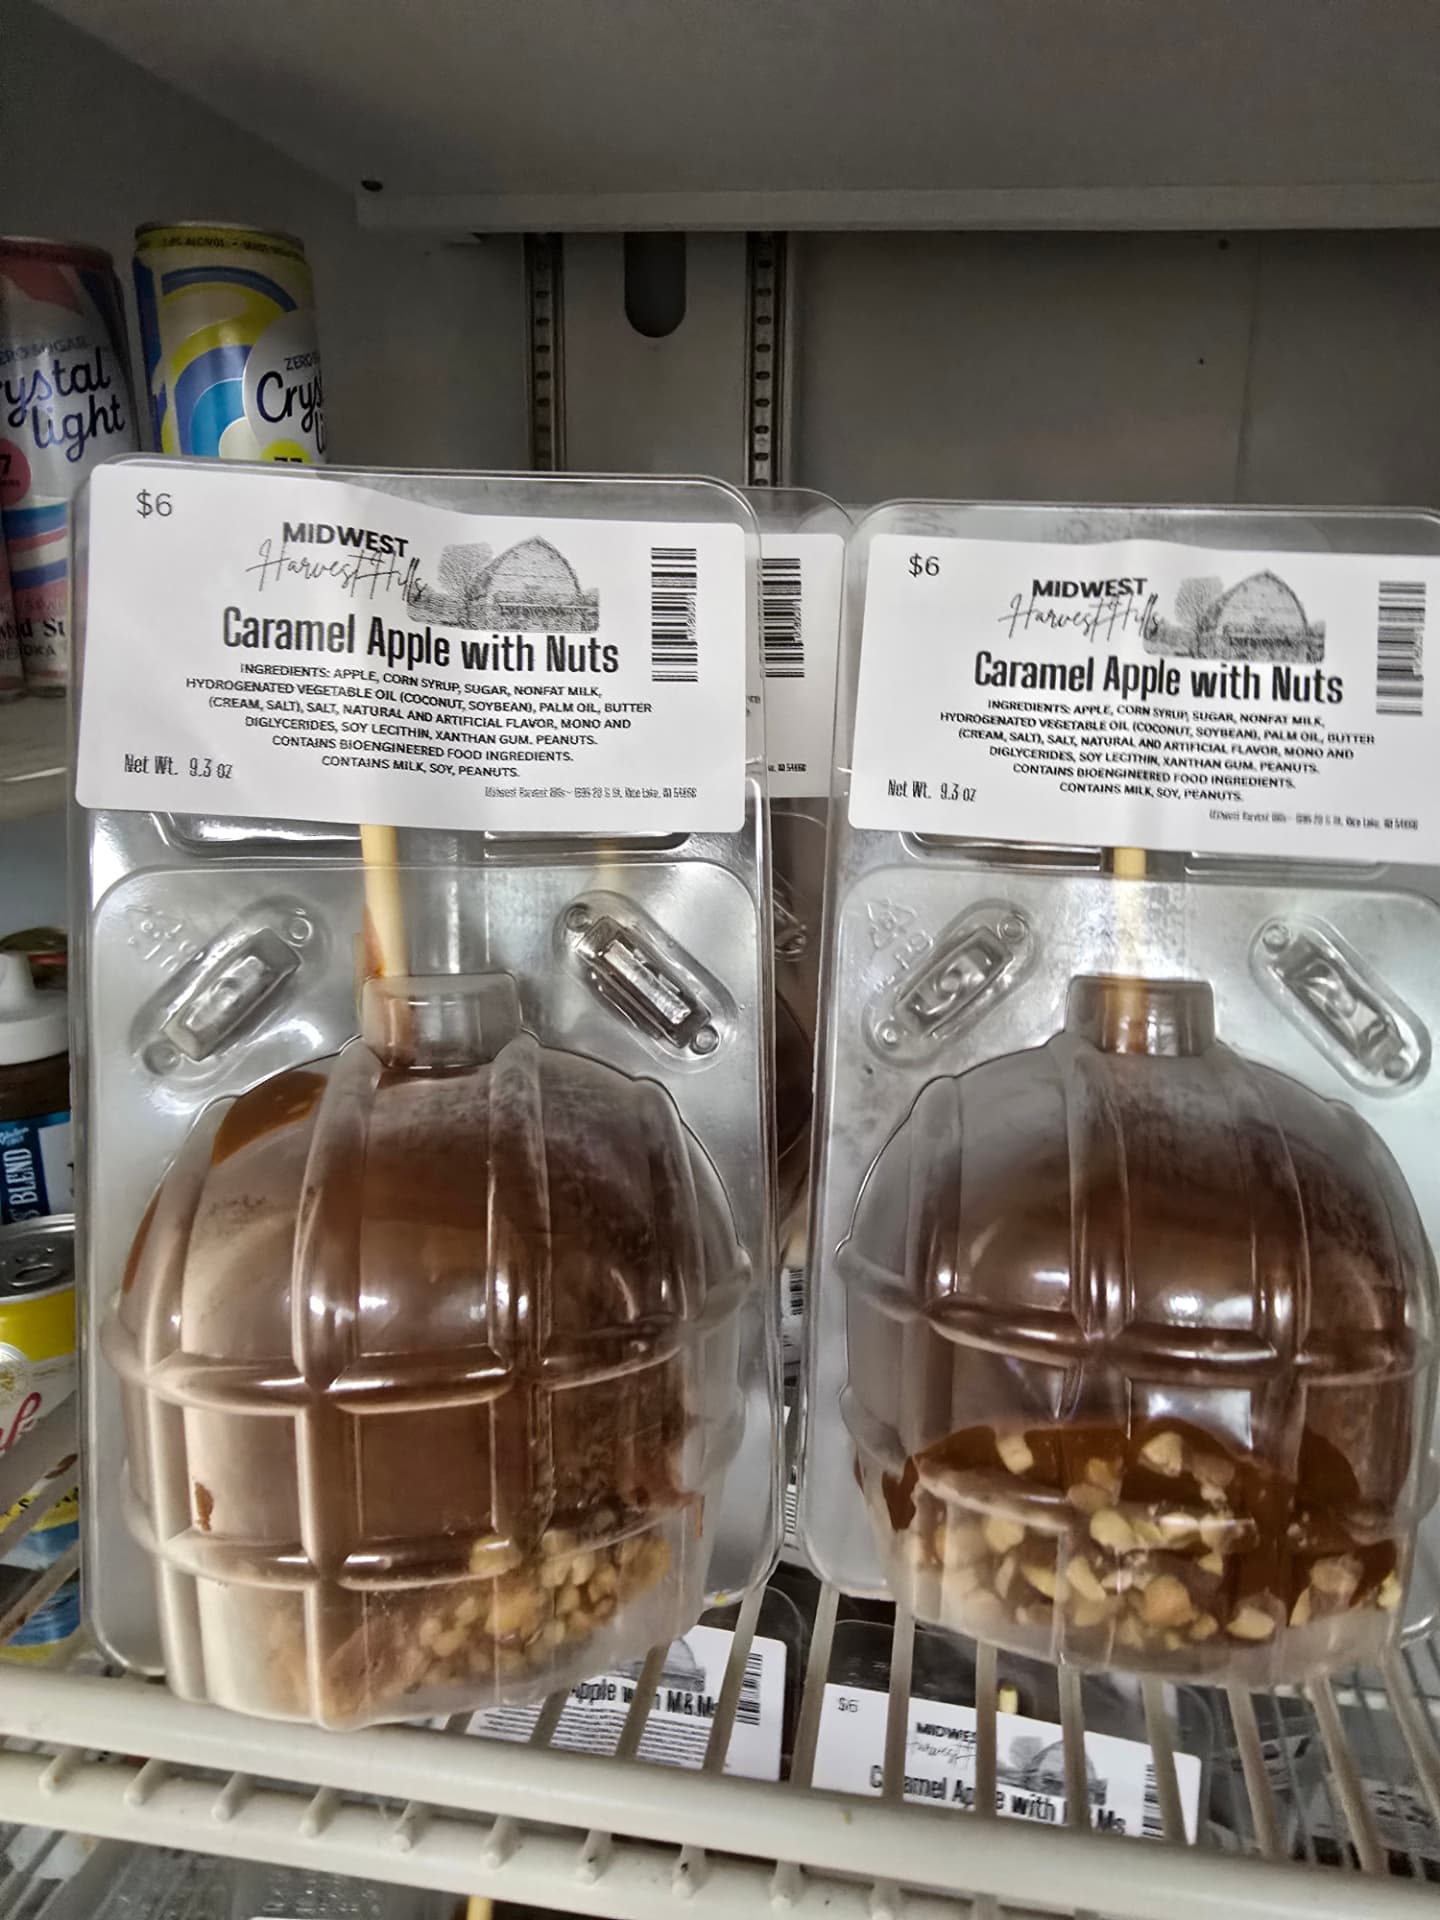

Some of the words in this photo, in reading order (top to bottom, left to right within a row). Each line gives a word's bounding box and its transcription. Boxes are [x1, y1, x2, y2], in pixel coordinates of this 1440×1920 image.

[0, 347, 110, 428] ystal
[32, 394, 125, 463] light
[136, 488, 172, 518] $6
[283, 522, 409, 557] MIDWEST
[245, 538, 385, 597] Harvest
[909, 552, 939, 578] $6
[1032, 577, 1147, 600] MIDWEST
[223, 605, 355, 654] Caramel
[367, 615, 450, 671] Apple
[461, 634, 534, 672] with
[547, 635, 619, 673] Nuts
[240, 663, 330, 679] INGREDIENTS:
[333, 669, 380, 683] APPLE,
[383, 672, 418, 686] CORN
[422, 678, 462, 694] SYRUP,
[464, 683, 511, 697] SUGAR,
[514, 685, 564, 697] NONFAT
[568, 686, 602, 698] MILK,
[974, 650, 1094, 692] Caramel
[1103, 655, 1181, 702] Apple
[1190, 662, 1261, 700] with
[1271, 664, 1344, 705] Nuts
[186, 678, 294, 694] HYDROGENATED
[298, 684, 372, 700] VEGETABLE
[375, 689, 396, 700] OIL
[400, 691, 466, 710] (COCONUT,
[539, 702, 573, 713] PALM
[576, 702, 601, 714] OIL,
[604, 702, 652, 714] BUTTER
[209, 697, 264, 711] (CREAM,
[266, 699, 304, 714] SALT),
[307, 702, 339, 715] SALT,
[343, 704, 404, 720] NATURAL
[407, 709, 432, 722] AND
[436, 714, 502, 728] ARTIFICIAL
[506, 718, 557, 730] FLAVOR,
[561, 719, 600, 729] MONO
[604, 719, 631, 729] AND
[987, 699, 1071, 714] INGREDIENTS:
[1073, 704, 1113, 717] APPLE,
[1116, 705, 1150, 717] CORN
[1153, 707, 1189, 722] SYRUP,
[1192, 711, 1236, 724] SUGAR,
[1240, 713, 1288, 725] NONFAT
[1292, 716, 1325, 727] MILK,
[245, 716, 338, 733] DIGLYCERIDES,
[341, 721, 368, 733] SOY
[371, 724, 433, 740] LECITHIN,
[436, 730, 496, 744] XANTHAN
[536, 735, 598, 745] PEANUTS.
[940, 712, 1036, 727] HYDROGENATED
[1039, 717, 1106, 731] VEGETABLE
[1109, 721, 1129, 731] OIL
[1132, 722, 1193, 737] (COCONUT,
[1264, 730, 1297, 741] PALM
[1300, 732, 1324, 744] OIL,
[1327, 733, 1375, 745] BUTTER
[272, 735, 336, 749] CONTAINS
[340, 740, 444, 758] BIOENGINEERED
[447, 748, 482, 760] FOOD
[486, 751, 574, 762] INGREDIENTS.
[958, 728, 1007, 742] (CREAM,
[1047, 734, 1077, 746] SALT,
[1081, 736, 1135, 748] NATURAL
[1138, 739, 1161, 749] AND
[1164, 741, 1228, 754] ARTIFICIAL
[1231, 745, 1281, 757] FLAVOR,
[1284, 747, 1323, 758] MONO
[1327, 748, 1354, 759] AND
[124, 753, 149, 774] Net
[155, 755, 178, 775] Wt.
[189, 757, 212, 777] 9.3
[322, 755, 389, 769] CONTAINS
[393, 761, 426, 773] MILK,
[429, 764, 456, 776] SOY,
[458, 765, 520, 777] PEANUTS.
[989, 746, 1076, 763] DIGLYCERIDES,
[1079, 751, 1101, 762] SOY
[1105, 752, 1160, 766] LECITHIN,
[1163, 756, 1221, 770] XANTHAN
[1260, 761, 1320, 773] PEANUTS.
[887, 778, 908, 798] Net
[912, 779, 932, 799] Wt.
[940, 782, 959, 800] 9.3
[1013, 763, 1074, 777] CONTAINS
[1076, 767, 1171, 782] BIOENGINEERED
[1174, 773, 1208, 784] FOOD
[1211, 776, 1295, 788] INGREDIENTS.
[1059, 782, 1121, 795] CONTAINS
[1124, 784, 1154, 797] MILK,
[1157, 787, 1181, 800] SOY,
[1184, 789, 1243, 801] PEANUTS.
[3, 1148, 38, 1205] BLEND
[572, 1679, 617, 1706] pple
[838, 1697, 858, 1713] $6
[916, 1722, 977, 1743] MIDWES
[870, 1764, 947, 1800] Camel
[1011, 1792, 1055, 1822] with
